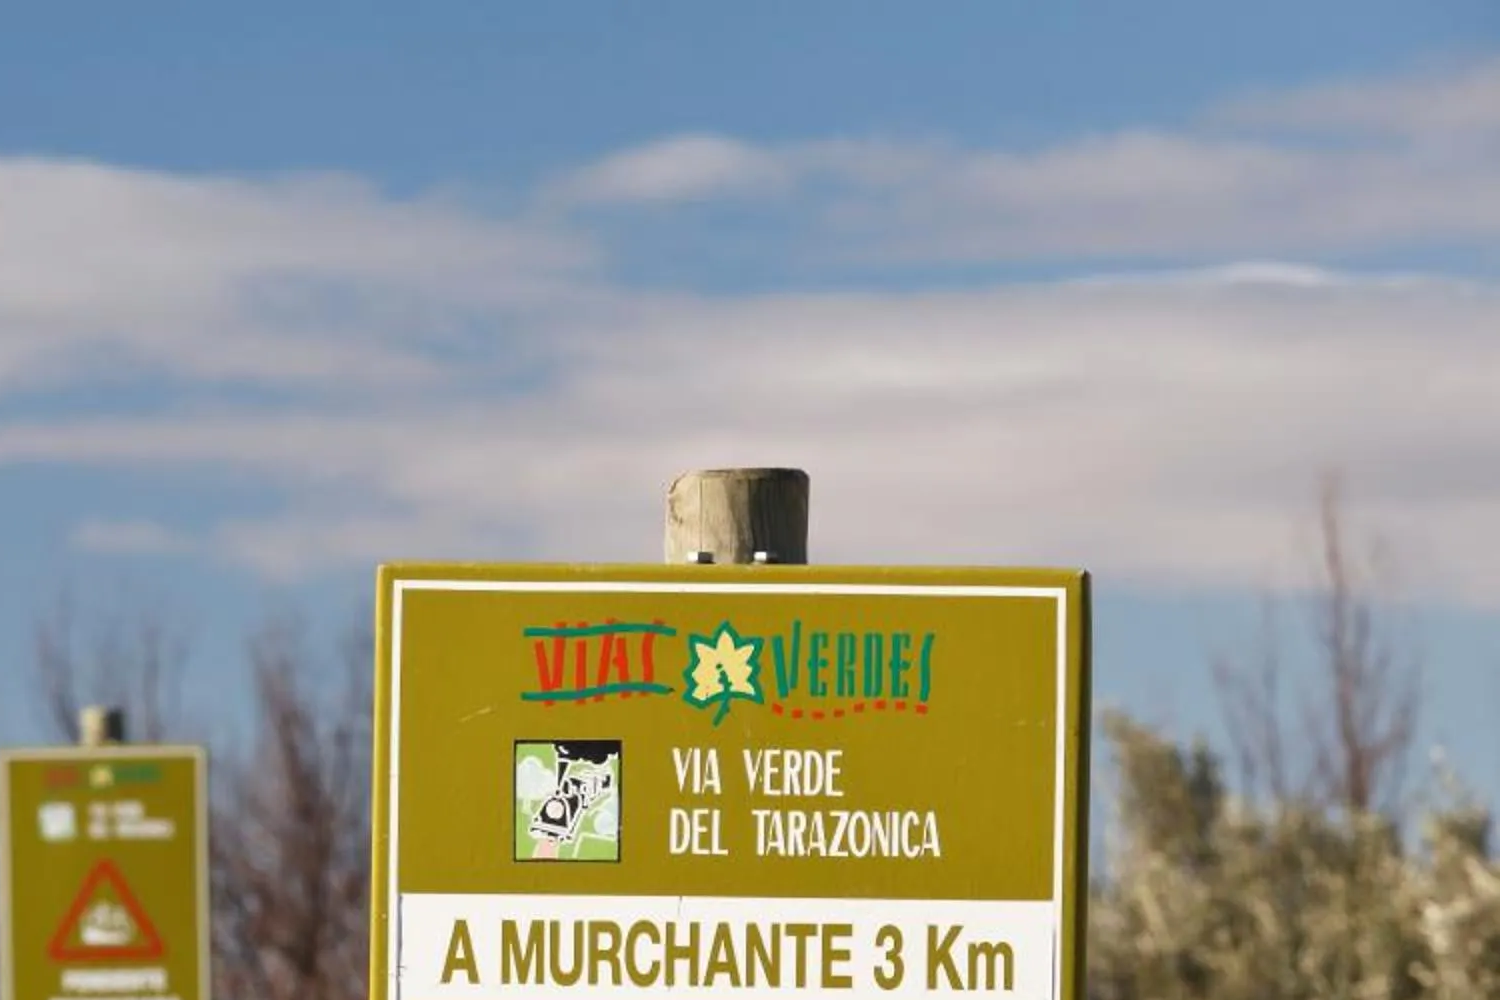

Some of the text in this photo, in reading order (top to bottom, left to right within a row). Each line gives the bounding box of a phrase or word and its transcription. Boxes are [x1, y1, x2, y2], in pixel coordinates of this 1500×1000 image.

[532, 618, 935, 707] VIAS VERDES
[672, 747, 844, 797] VIA VERDE
[669, 808, 941, 859] DEL TARAZONICA
[440, 918, 1015, 993] A MURCHANTE 3 Km
